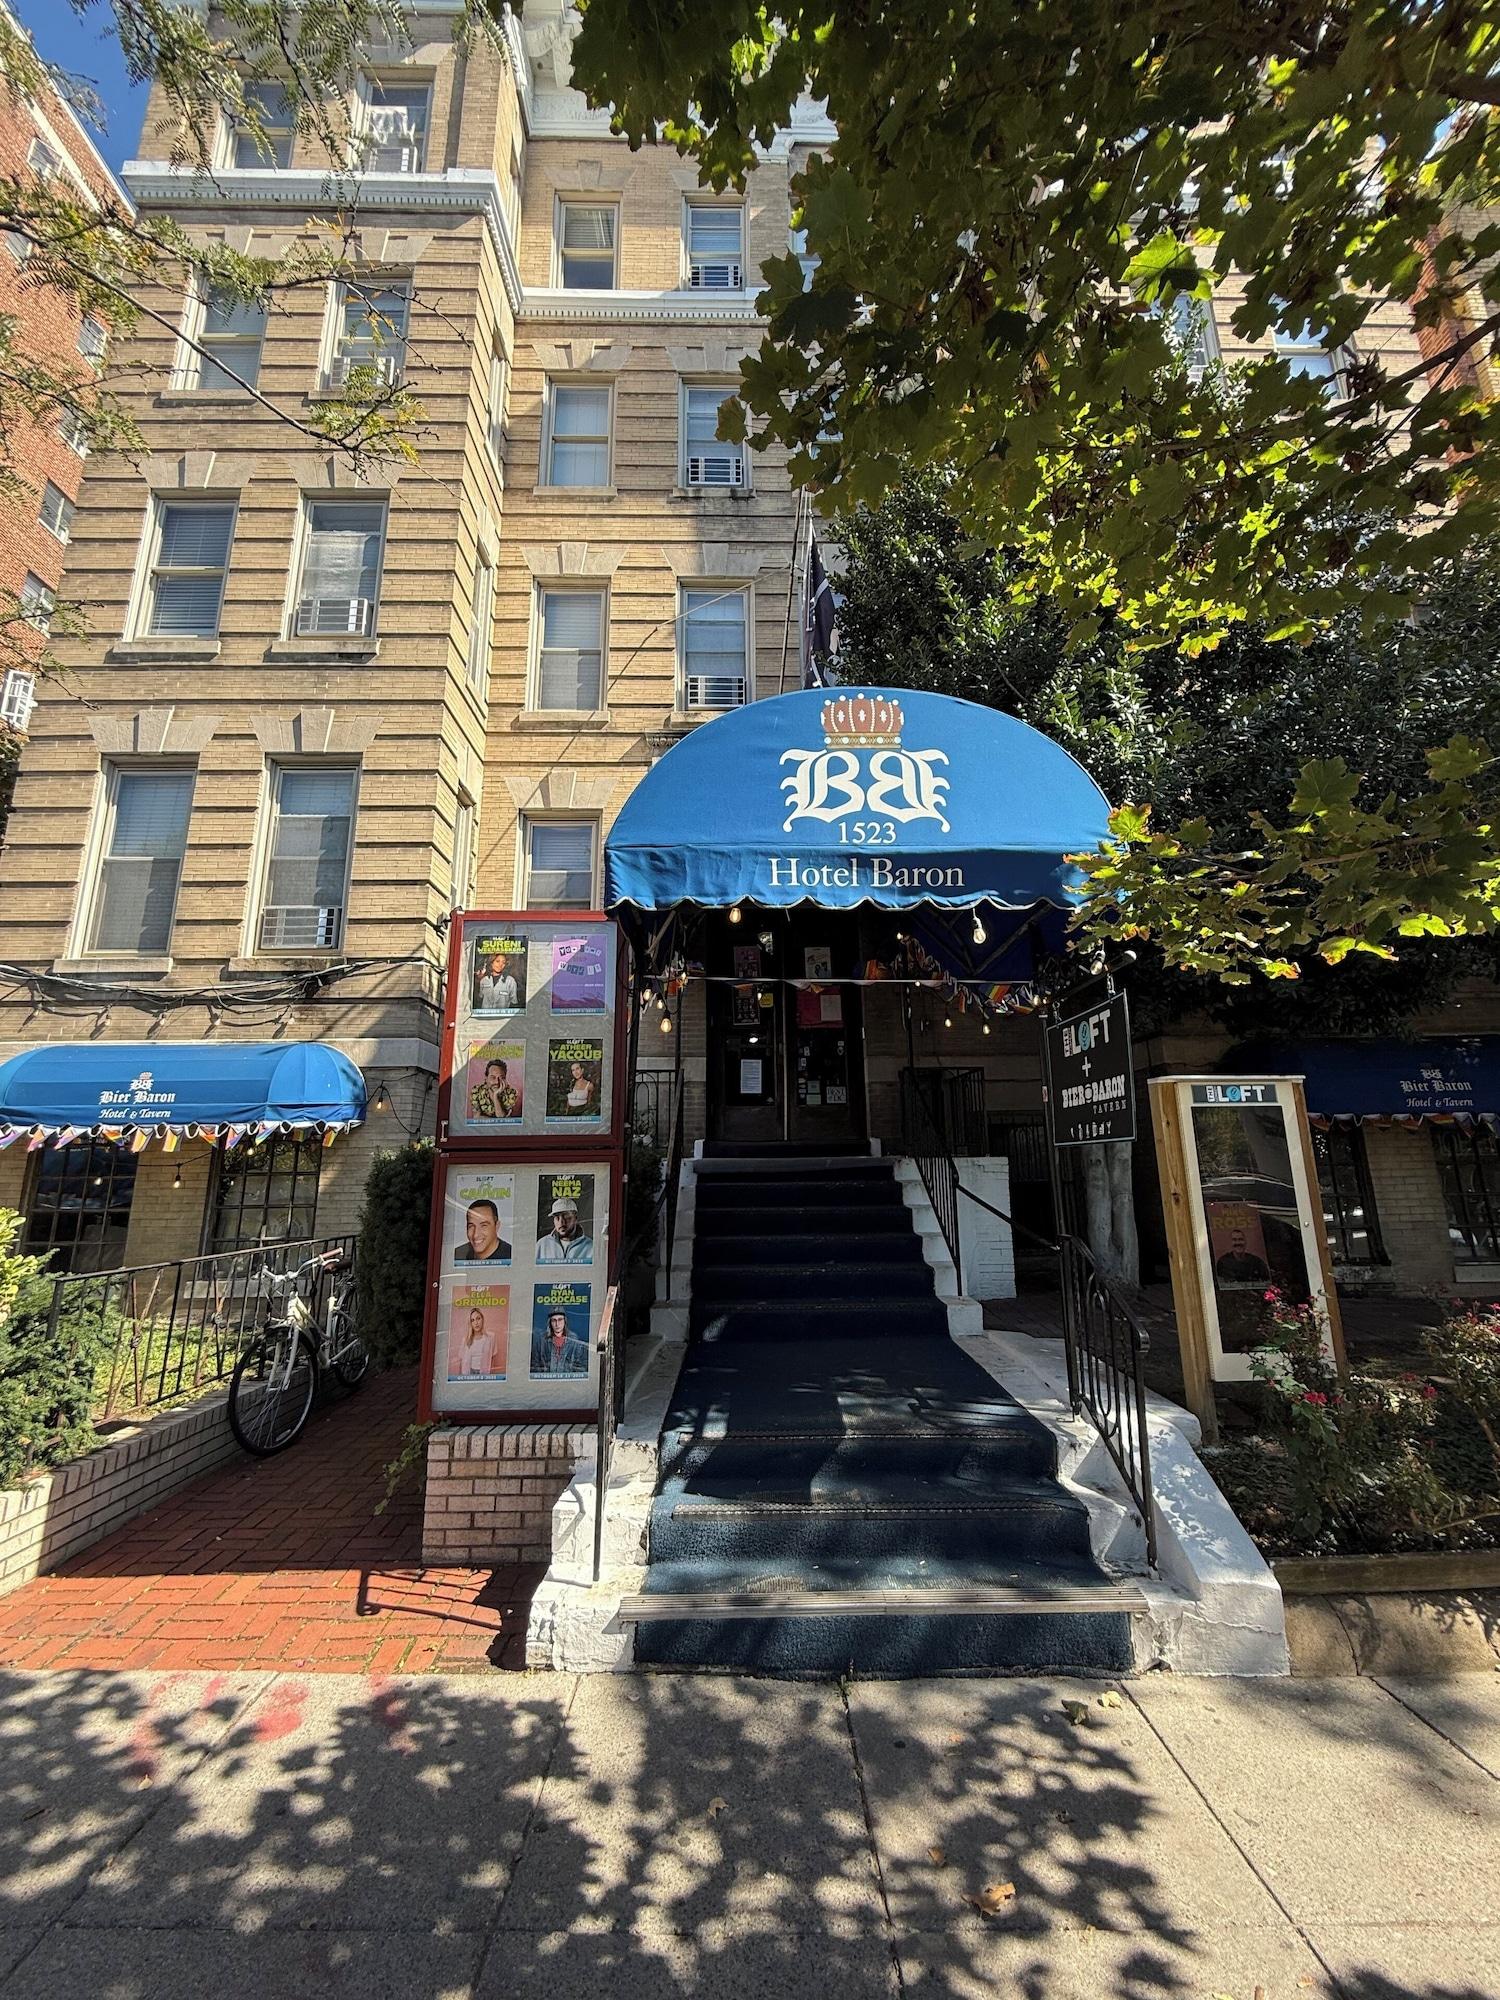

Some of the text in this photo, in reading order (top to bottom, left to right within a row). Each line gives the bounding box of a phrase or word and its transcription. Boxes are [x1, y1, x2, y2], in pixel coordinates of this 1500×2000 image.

[838, 822, 897, 844] 1523
[768, 857, 965, 888] Hotel Baron
[482, 940, 521, 948] SURENI
[1071, 1009, 1111, 1055] LOFT
[550, 1050, 602, 1060] YACOUB
[1062, 1074, 1126, 1109] BIER BARON
[1400, 1080, 1473, 1093] Bier Baron
[99, 1090, 176, 1105] Bier Baron
[1206, 1085, 1216, 1103] THE
[1217, 1085, 1265, 1102] LOFT
[1092, 1100, 1127, 1114] TAVERN
[1406, 1097, 1433, 1108] Hotel
[1443, 1097, 1474, 1107] Tavern
[98, 1108, 171, 1119] Hotel & Tavern
[552, 1187, 581, 1197] NAZ
[455, 1297, 507, 1307] ORLANDO
[536, 1295, 588, 1303] GOODCASE
